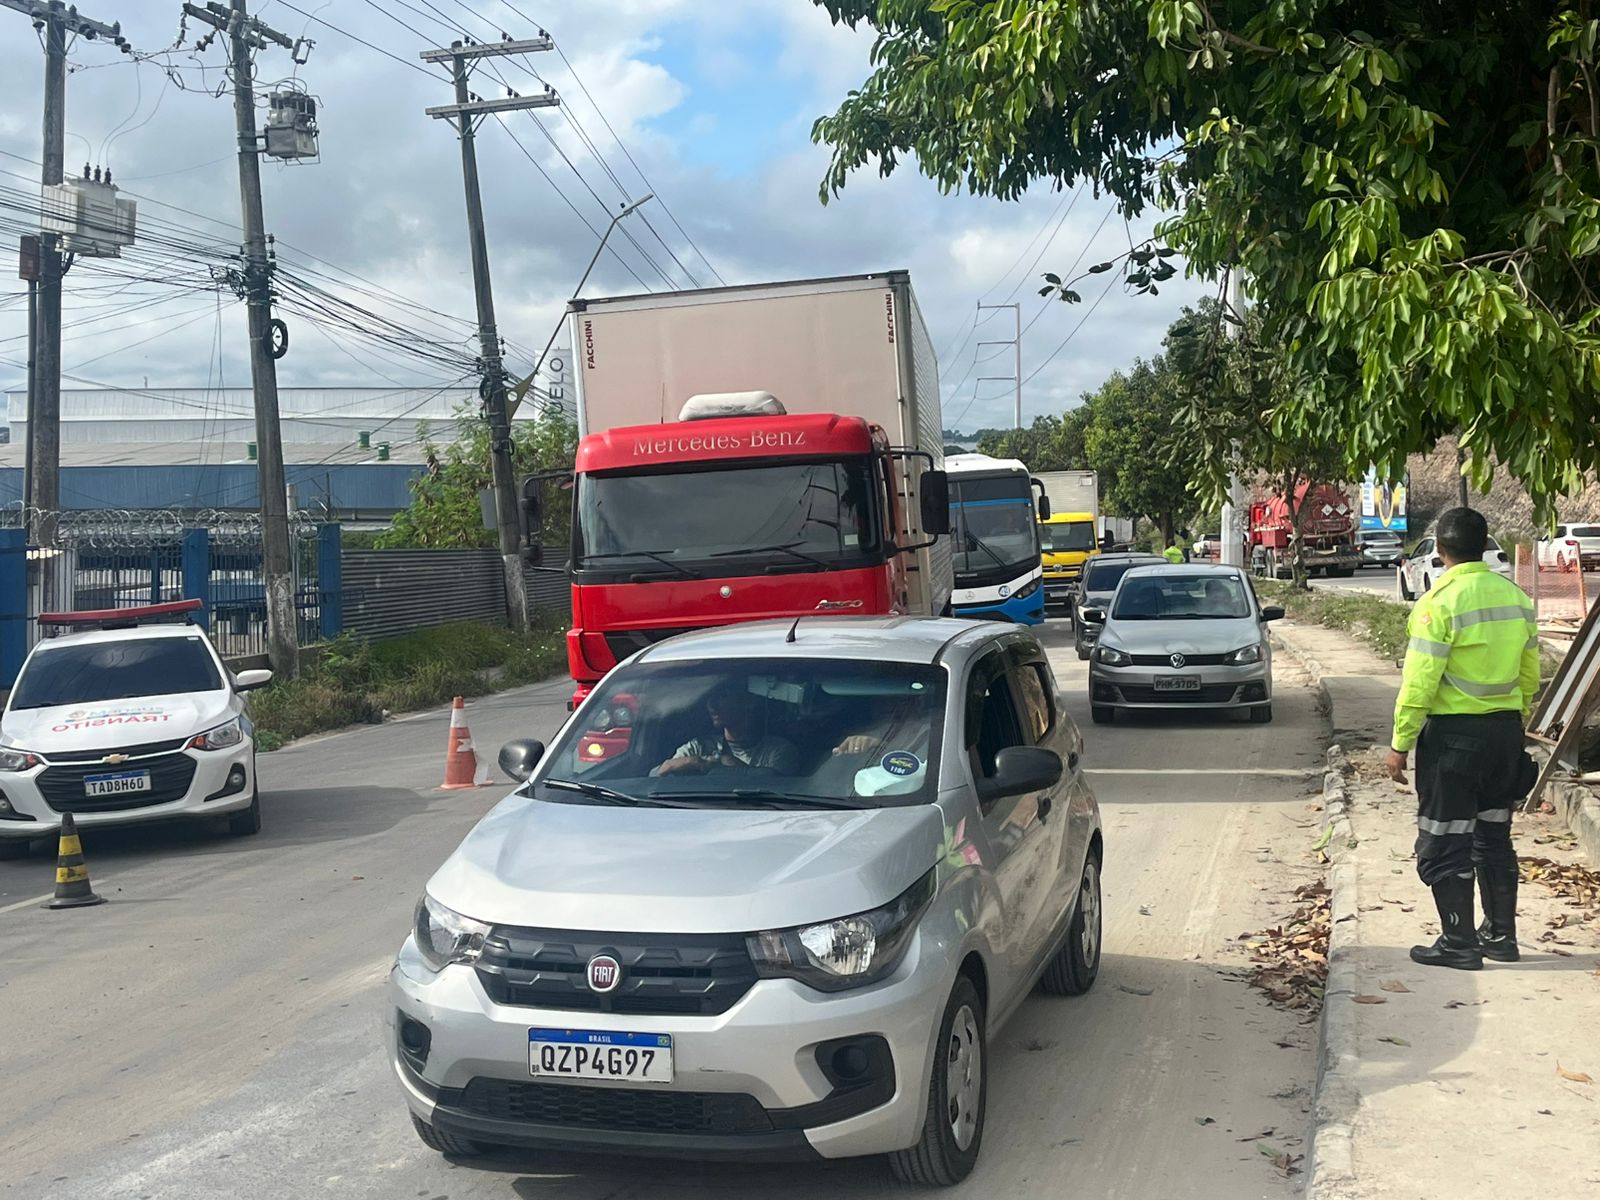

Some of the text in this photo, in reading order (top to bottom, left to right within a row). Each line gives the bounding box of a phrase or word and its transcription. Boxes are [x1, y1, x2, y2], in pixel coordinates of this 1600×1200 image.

[584, 320, 595, 370] FACCHINI
[632, 430, 806, 456] Mercedes-Benz
[593, 966, 614, 983] FIAT
[588, 1035, 612, 1044] BRASIL
[541, 1045, 656, 1077] QZP4G97
